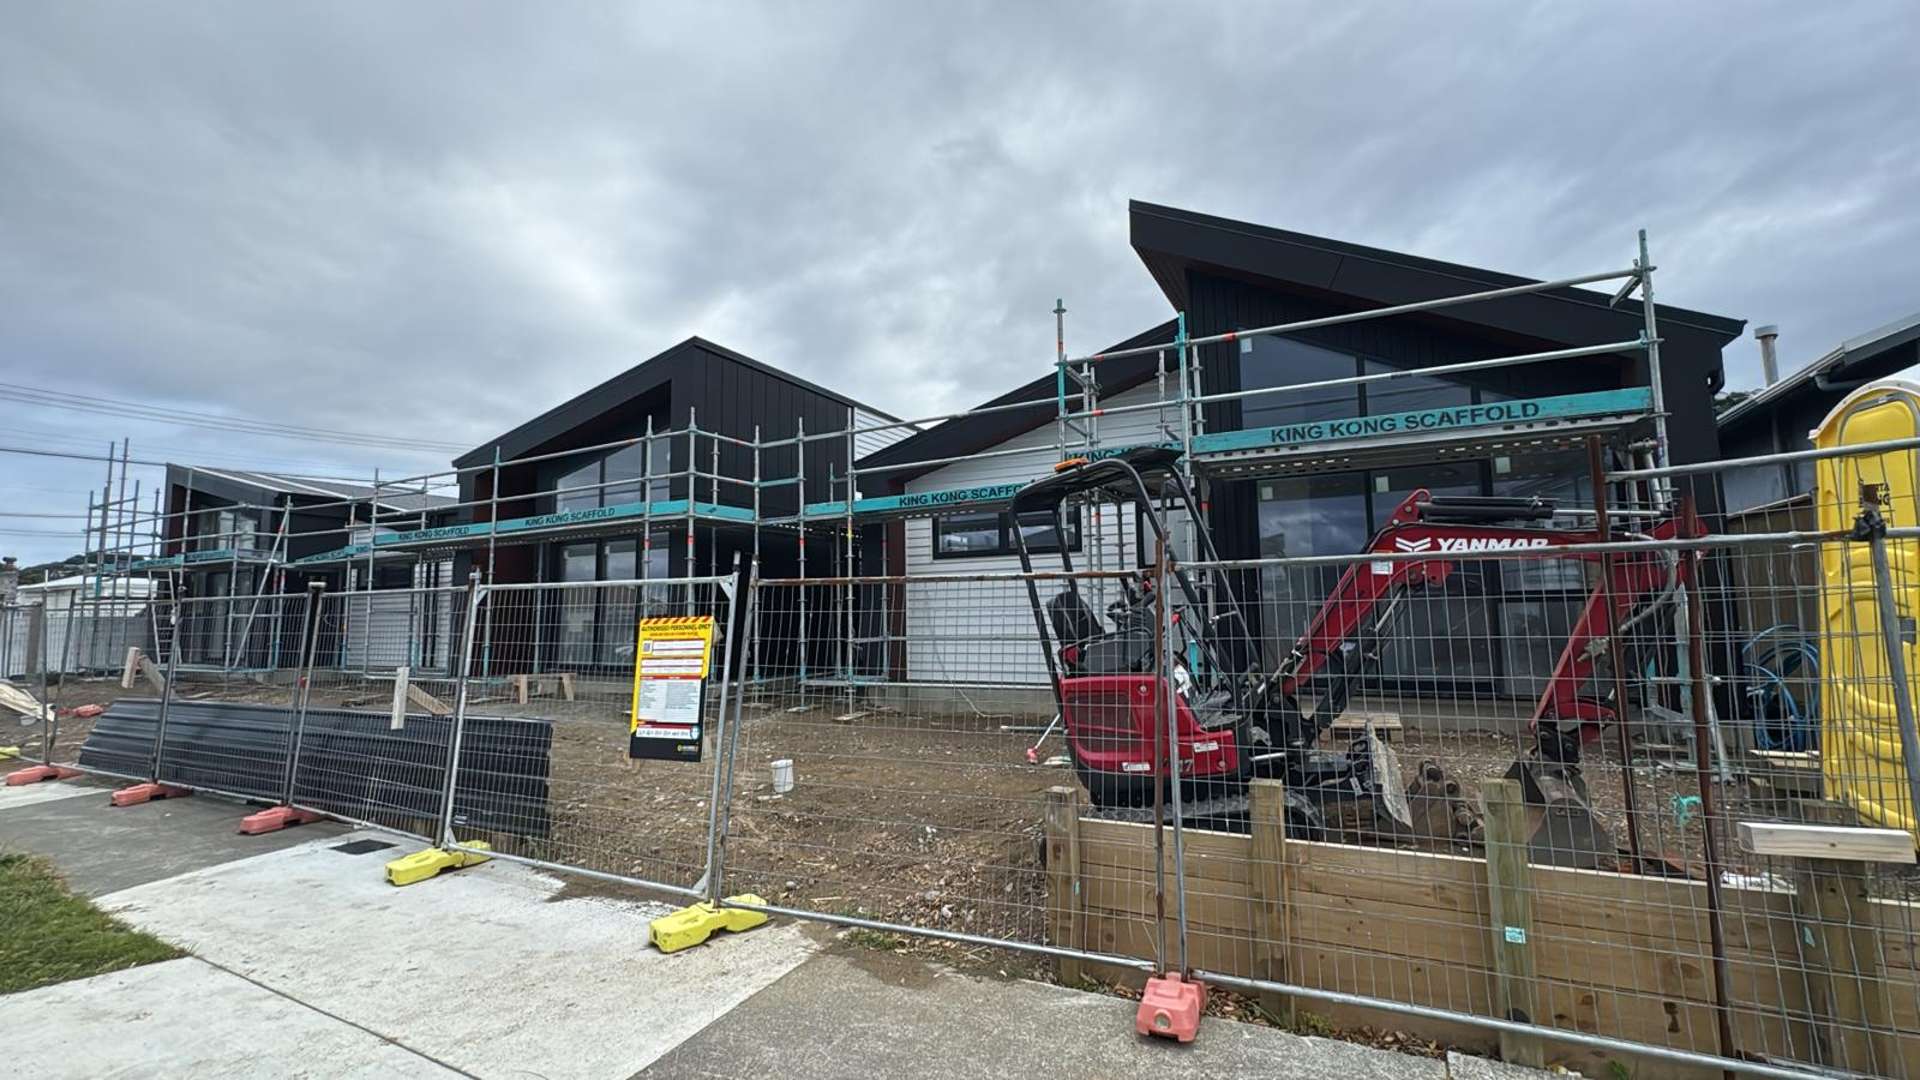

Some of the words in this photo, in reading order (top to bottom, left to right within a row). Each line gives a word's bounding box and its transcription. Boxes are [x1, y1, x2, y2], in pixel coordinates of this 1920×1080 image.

[1271, 425, 1323, 442] KING
[1330, 417, 1397, 437] KONG
[1404, 402, 1539, 430] SCAFFOLD
[899, 494, 929, 506] KING
[931, 490, 968, 504] KONG
[970, 484, 1025, 499] SCAFFO
[570, 507, 616, 521] SCAFFOLD
[1437, 538, 1549, 553] YANMAR
